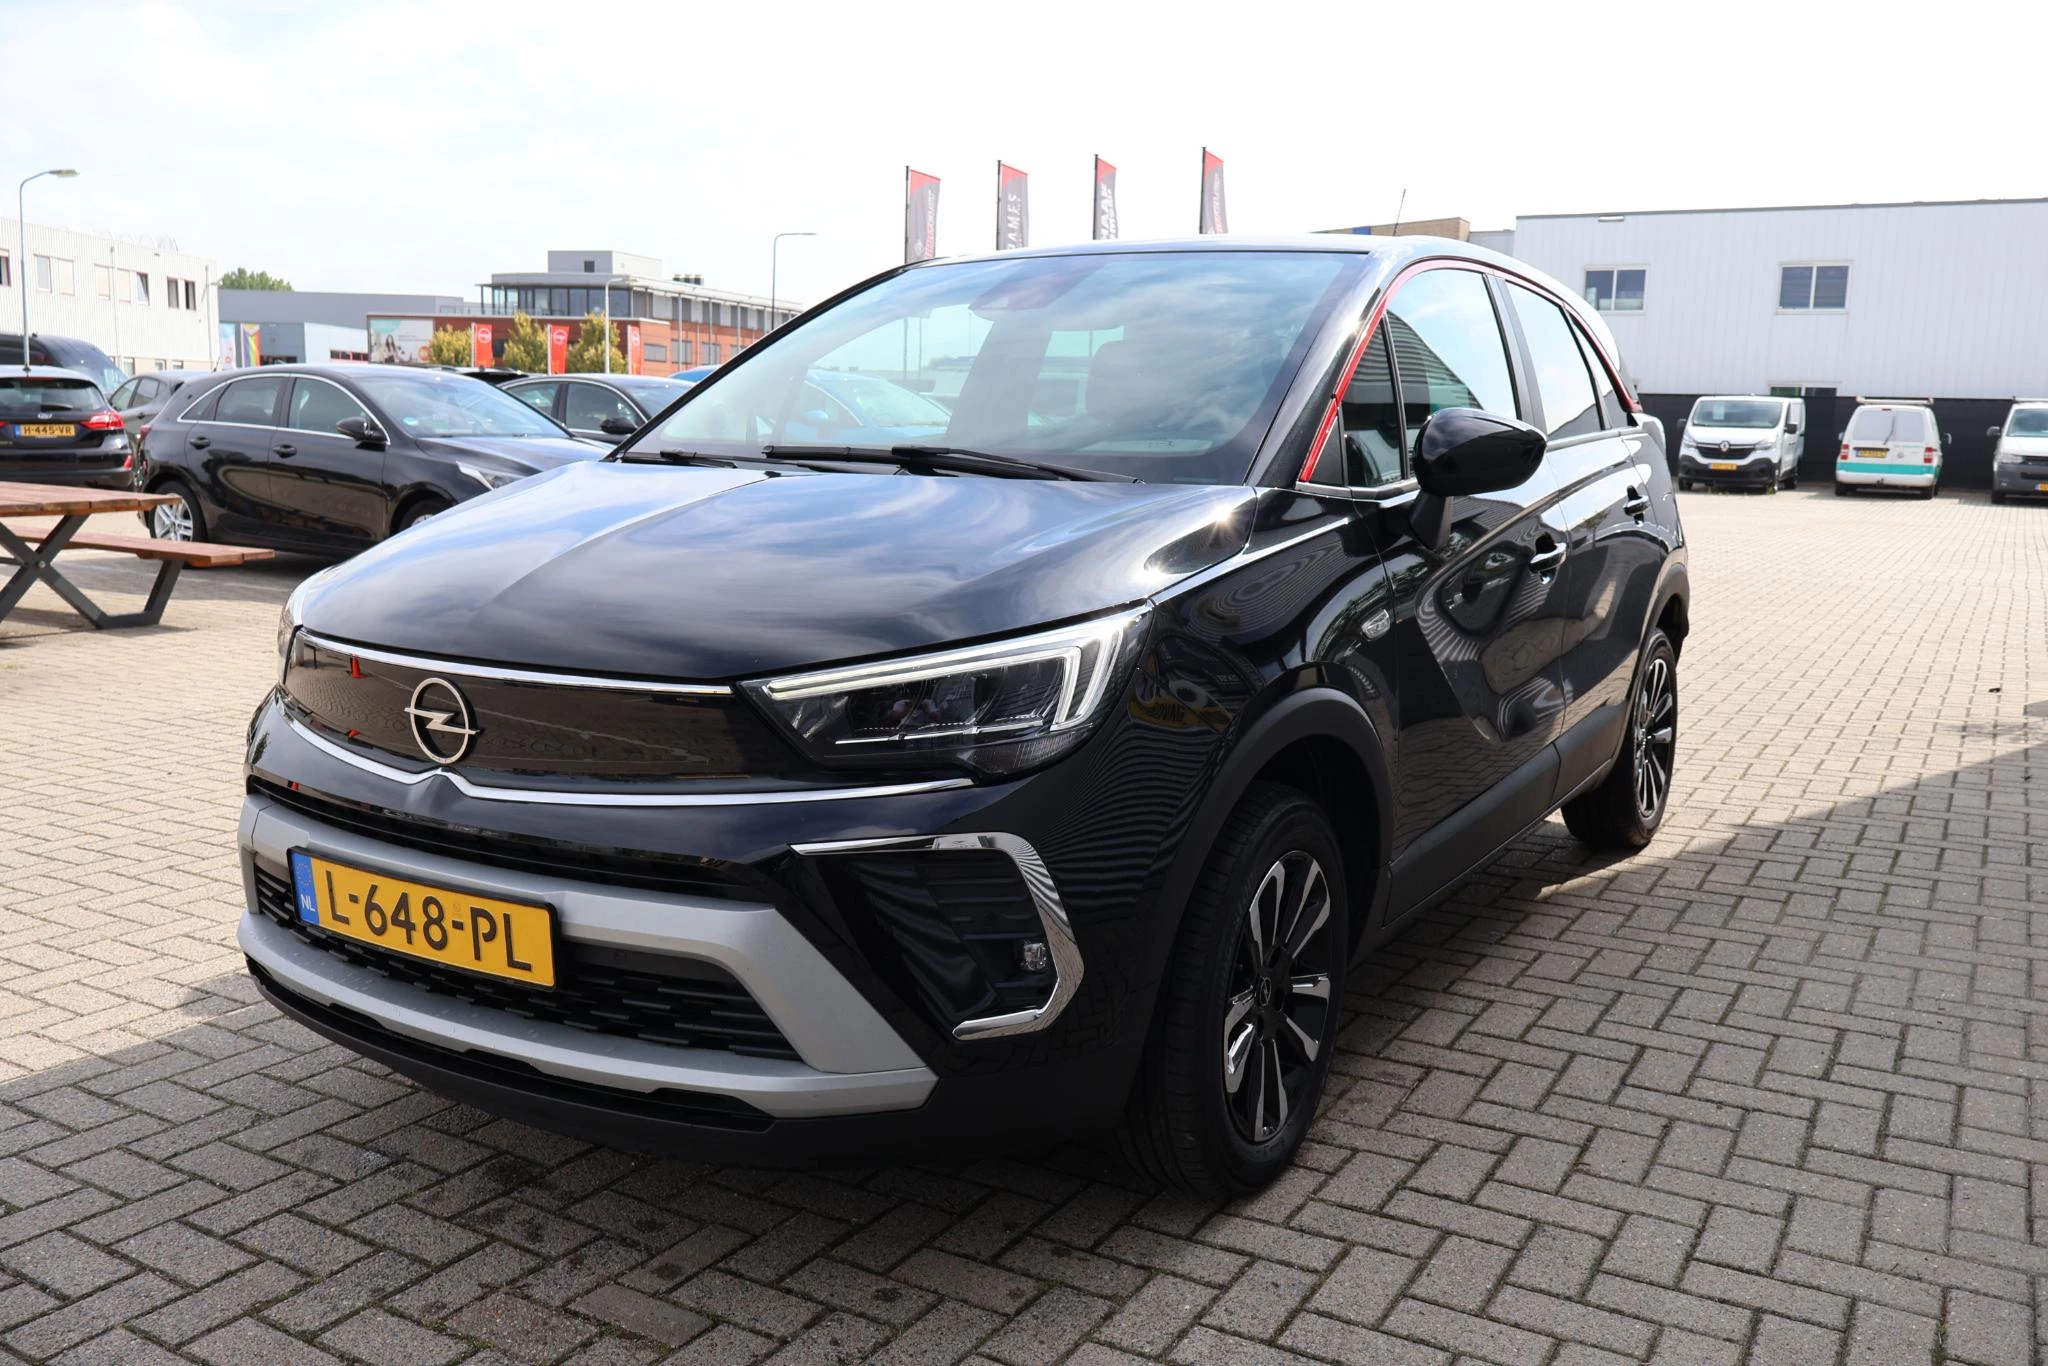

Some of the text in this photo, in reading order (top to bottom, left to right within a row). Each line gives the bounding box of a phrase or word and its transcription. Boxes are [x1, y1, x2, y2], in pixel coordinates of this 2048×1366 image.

[23, 424, 72, 435] H-445-VR
[300, 893, 316, 913] NL
[326, 870, 533, 973] L-648-PL
